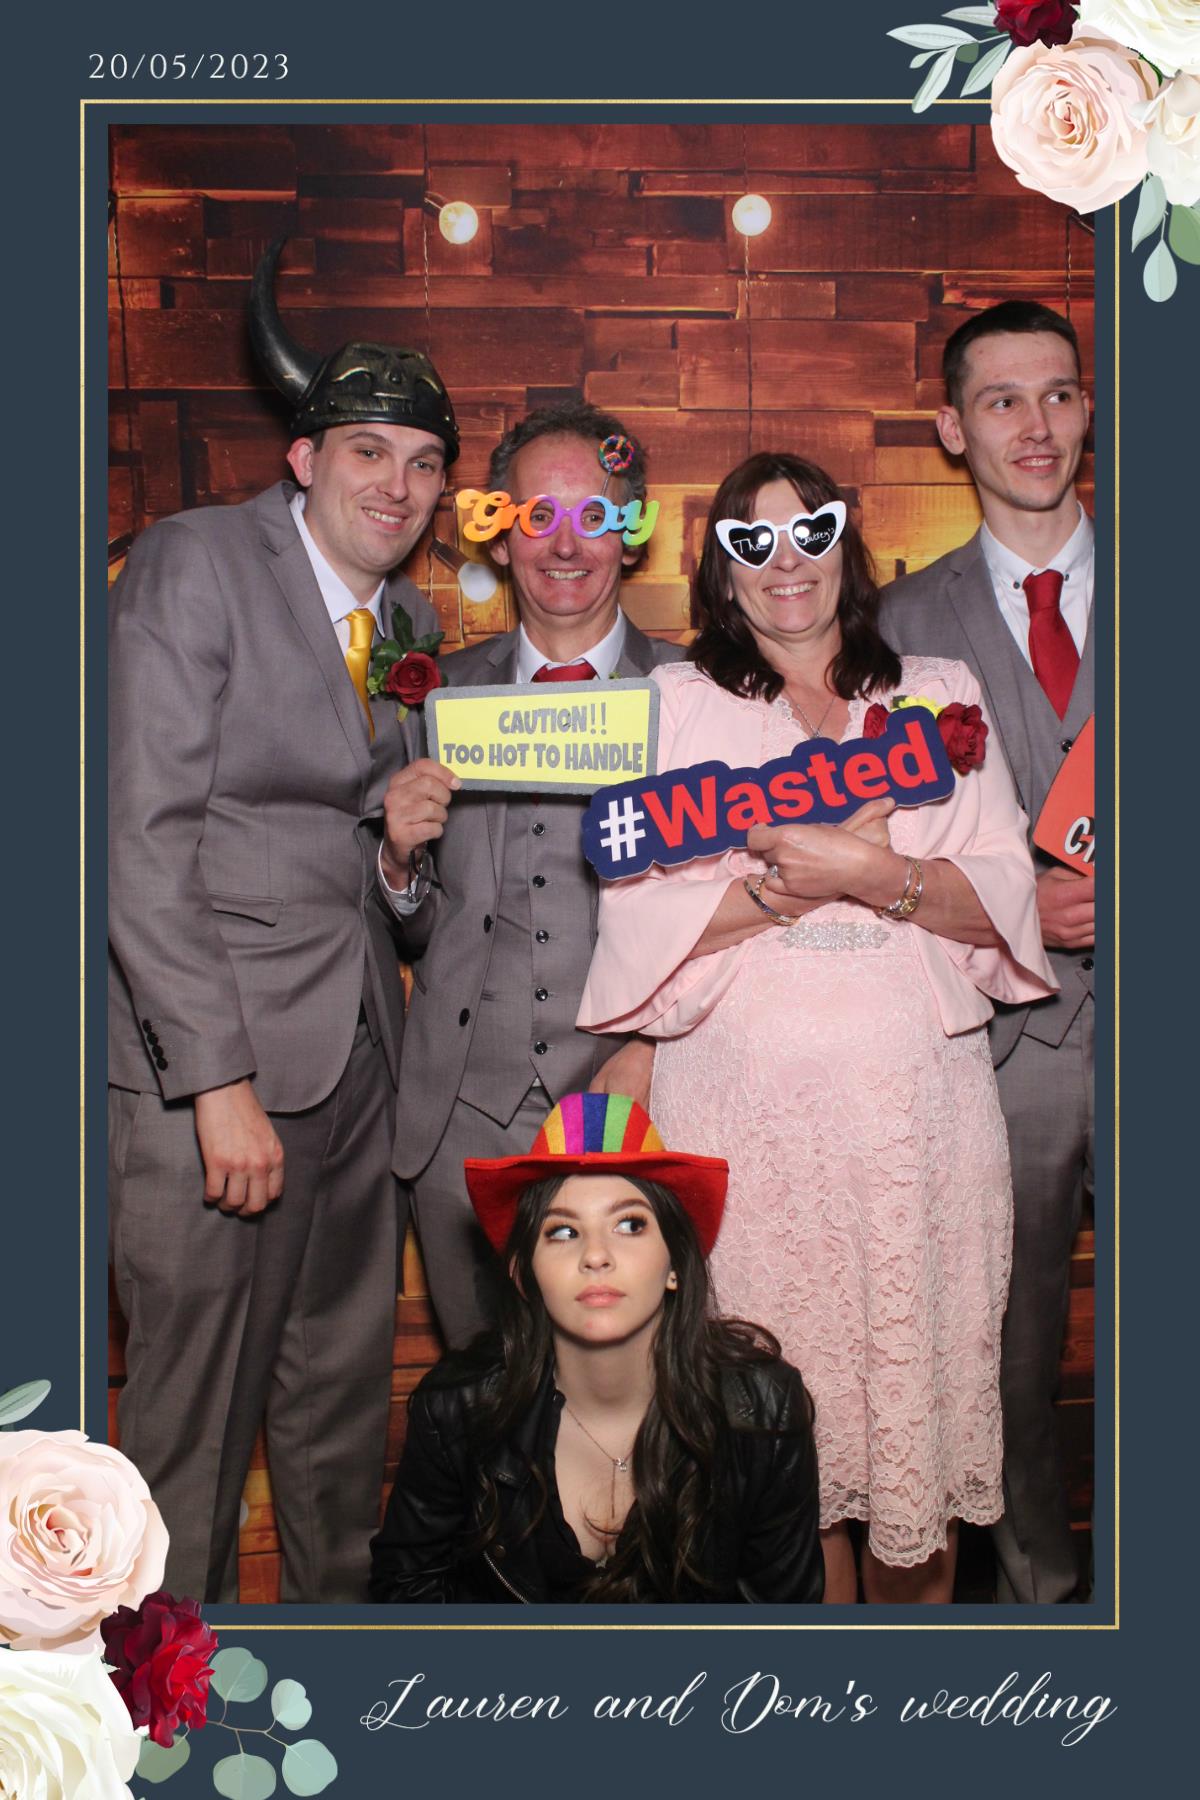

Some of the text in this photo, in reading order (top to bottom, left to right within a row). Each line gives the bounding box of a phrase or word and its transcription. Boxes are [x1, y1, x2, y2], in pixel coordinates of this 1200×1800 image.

[732, 538, 769, 554] The
[498, 702, 607, 735] CAUTION!!
[443, 742, 644, 774] TOO HOT TO HANDLE
[599, 719, 939, 863] #Wasted
